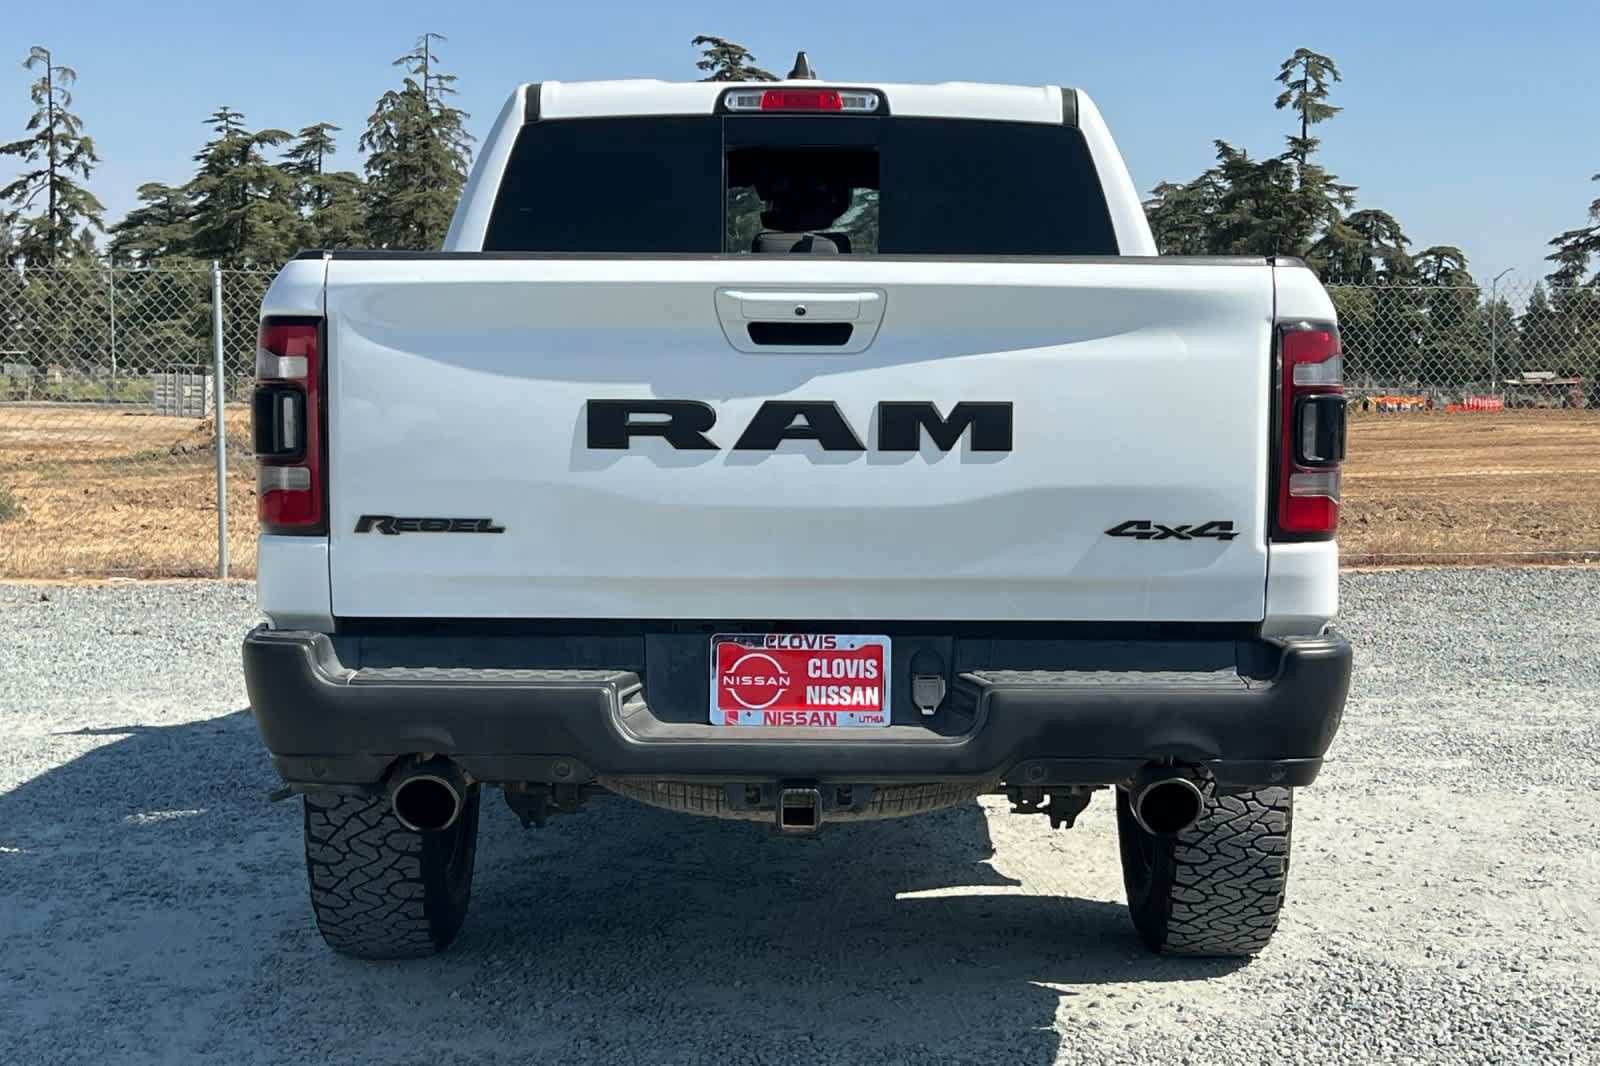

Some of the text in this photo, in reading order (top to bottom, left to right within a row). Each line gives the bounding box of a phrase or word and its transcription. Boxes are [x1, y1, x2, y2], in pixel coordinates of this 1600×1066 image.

[587, 399, 1013, 451] RAM
[354, 515, 506, 535] REBEL
[1104, 520, 1240, 540] 4x4
[765, 635, 836, 649] CLOVIS
[807, 658, 878, 679] CLOVIS
[723, 676, 790, 686] NISSAN
[806, 686, 879, 706] NISSAN
[763, 711, 837, 726] NISSAN
